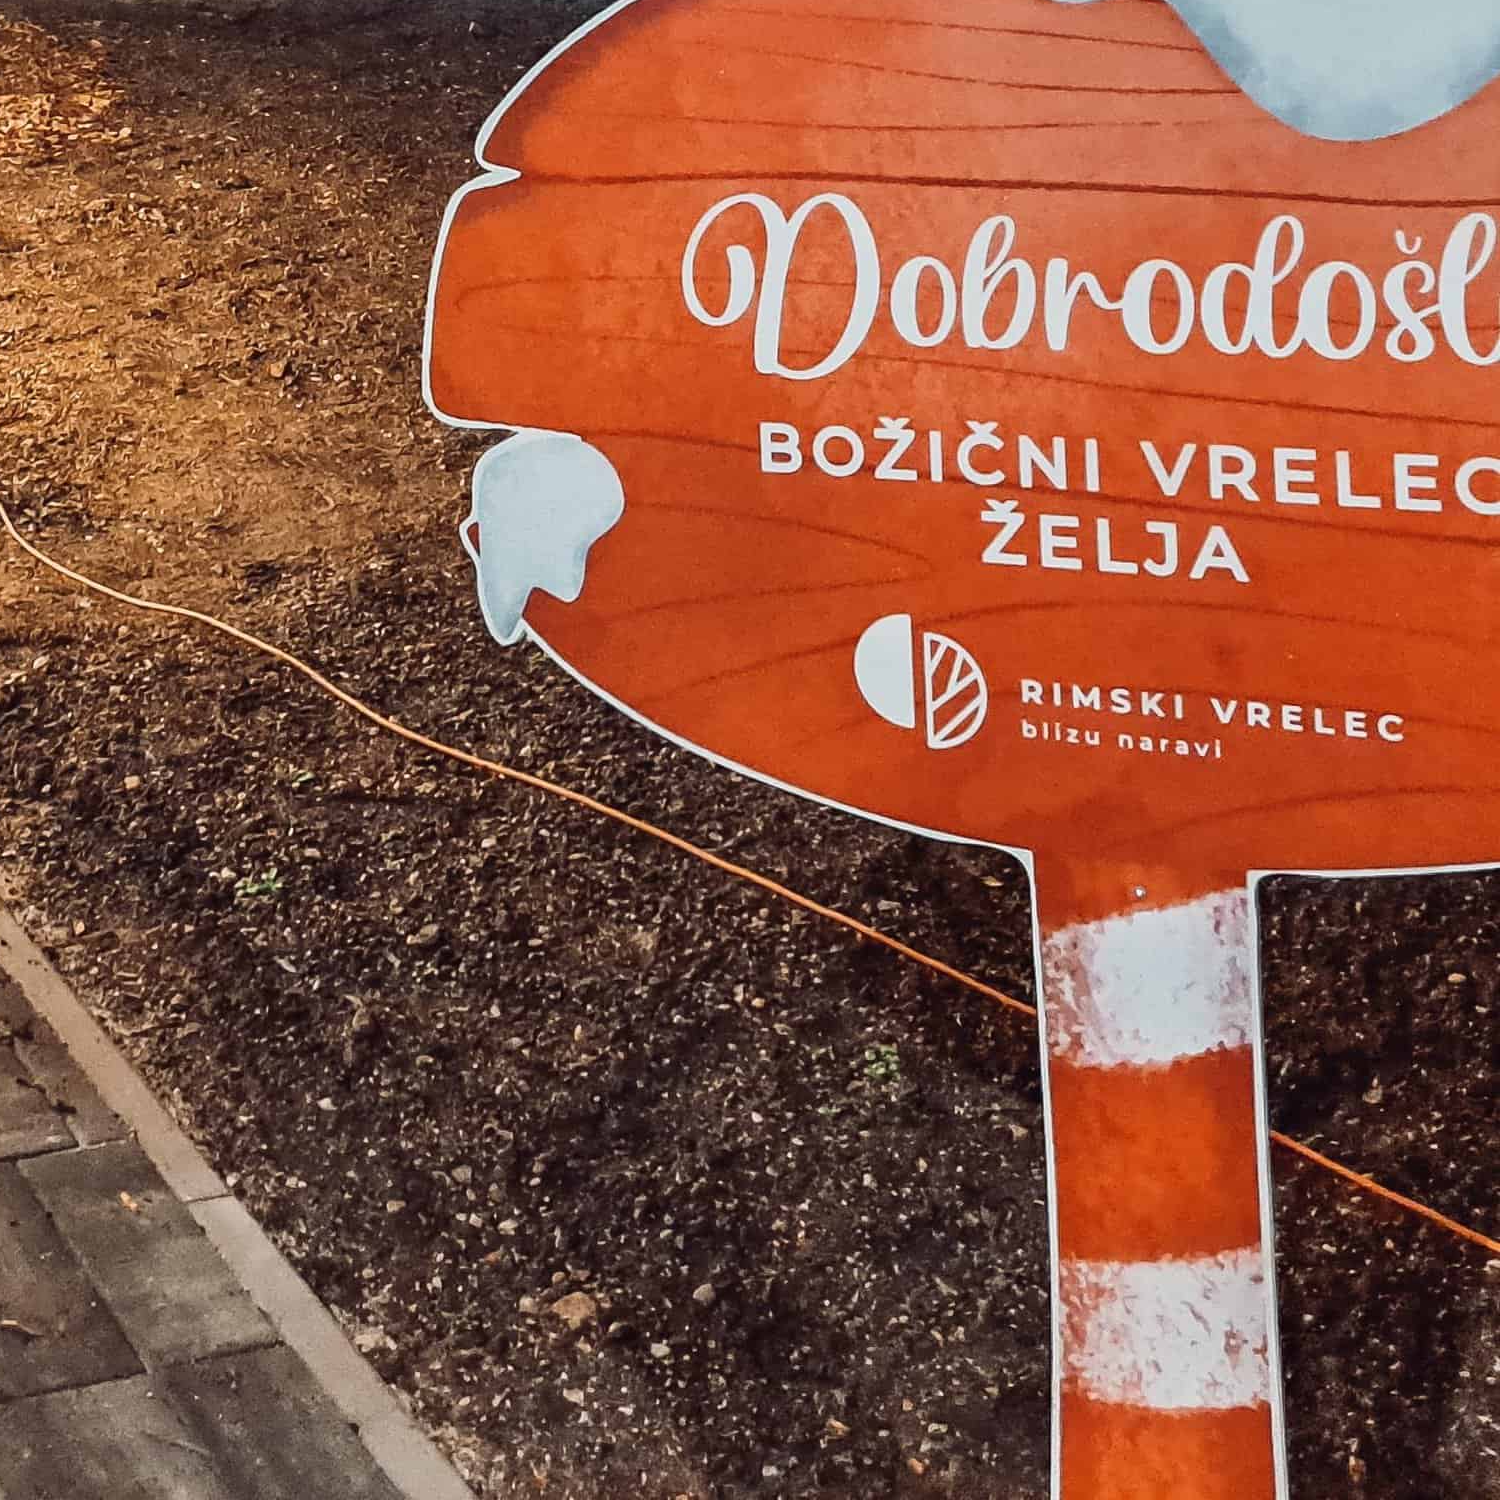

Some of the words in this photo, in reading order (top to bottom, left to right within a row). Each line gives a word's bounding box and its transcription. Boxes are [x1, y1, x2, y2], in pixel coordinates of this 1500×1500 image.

[681, 192, 1500, 381] Dobrodošl
[759, 416, 1100, 493] BOŽIČNI
[1139, 440, 1500, 516] VRELEC
[980, 499, 1250, 583] ŽELJA
[1020, 678, 1184, 720] RIMSKI
[1210, 697, 1405, 743] VRELEC
[1021, 719, 1101, 747] blizu
[1117, 733, 1222, 759] naravi
